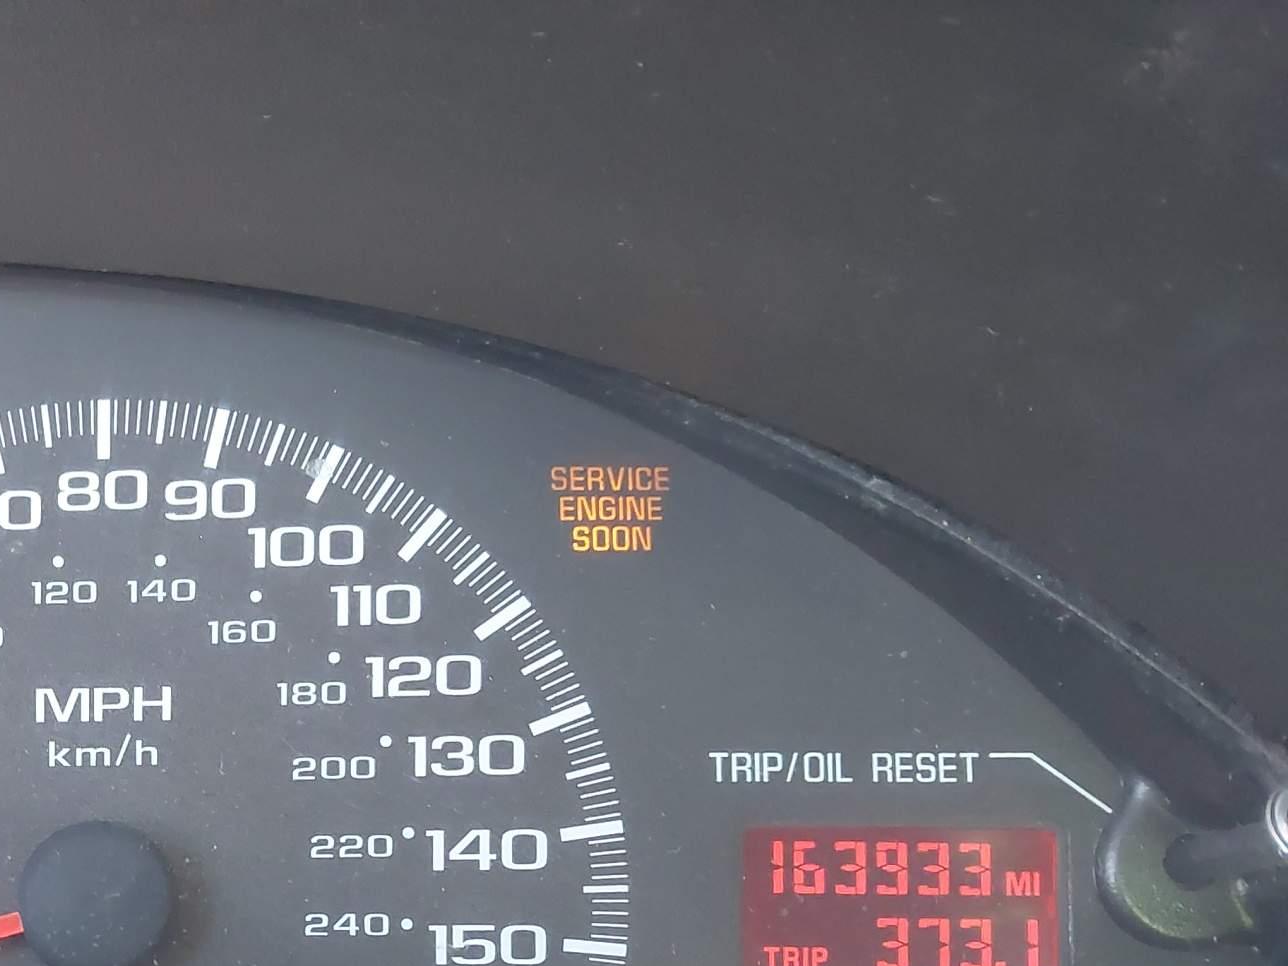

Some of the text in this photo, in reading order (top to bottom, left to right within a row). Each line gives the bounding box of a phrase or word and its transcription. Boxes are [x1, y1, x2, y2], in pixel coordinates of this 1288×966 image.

[57, 469, 149, 512] 80
[550, 465, 670, 493] SERVICE
[163, 477, 257, 521] 90
[558, 496, 664, 522] ENGINE
[247, 524, 365, 569] 100
[571, 526, 653, 553] SOON
[30, 580, 99, 604] 120
[126, 577, 197, 604] 140
[329, 583, 422, 628] 110
[207, 618, 277, 645] 160
[276, 680, 347, 706] 180
[364, 653, 483, 698] 120
[34, 685, 174, 723] MPH
[47, 732, 159, 769] km/h
[407, 734, 526, 777] 130
[709, 751, 980, 784] TRIP/OIL RESET
[292, 756, 376, 781] 200
[310, 834, 394, 859] 220
[425, 828, 548, 872] 140
[770, 840, 1041, 897] 163933 MI
[304, 912, 390, 937] 240
[428, 923, 547, 966] 150
